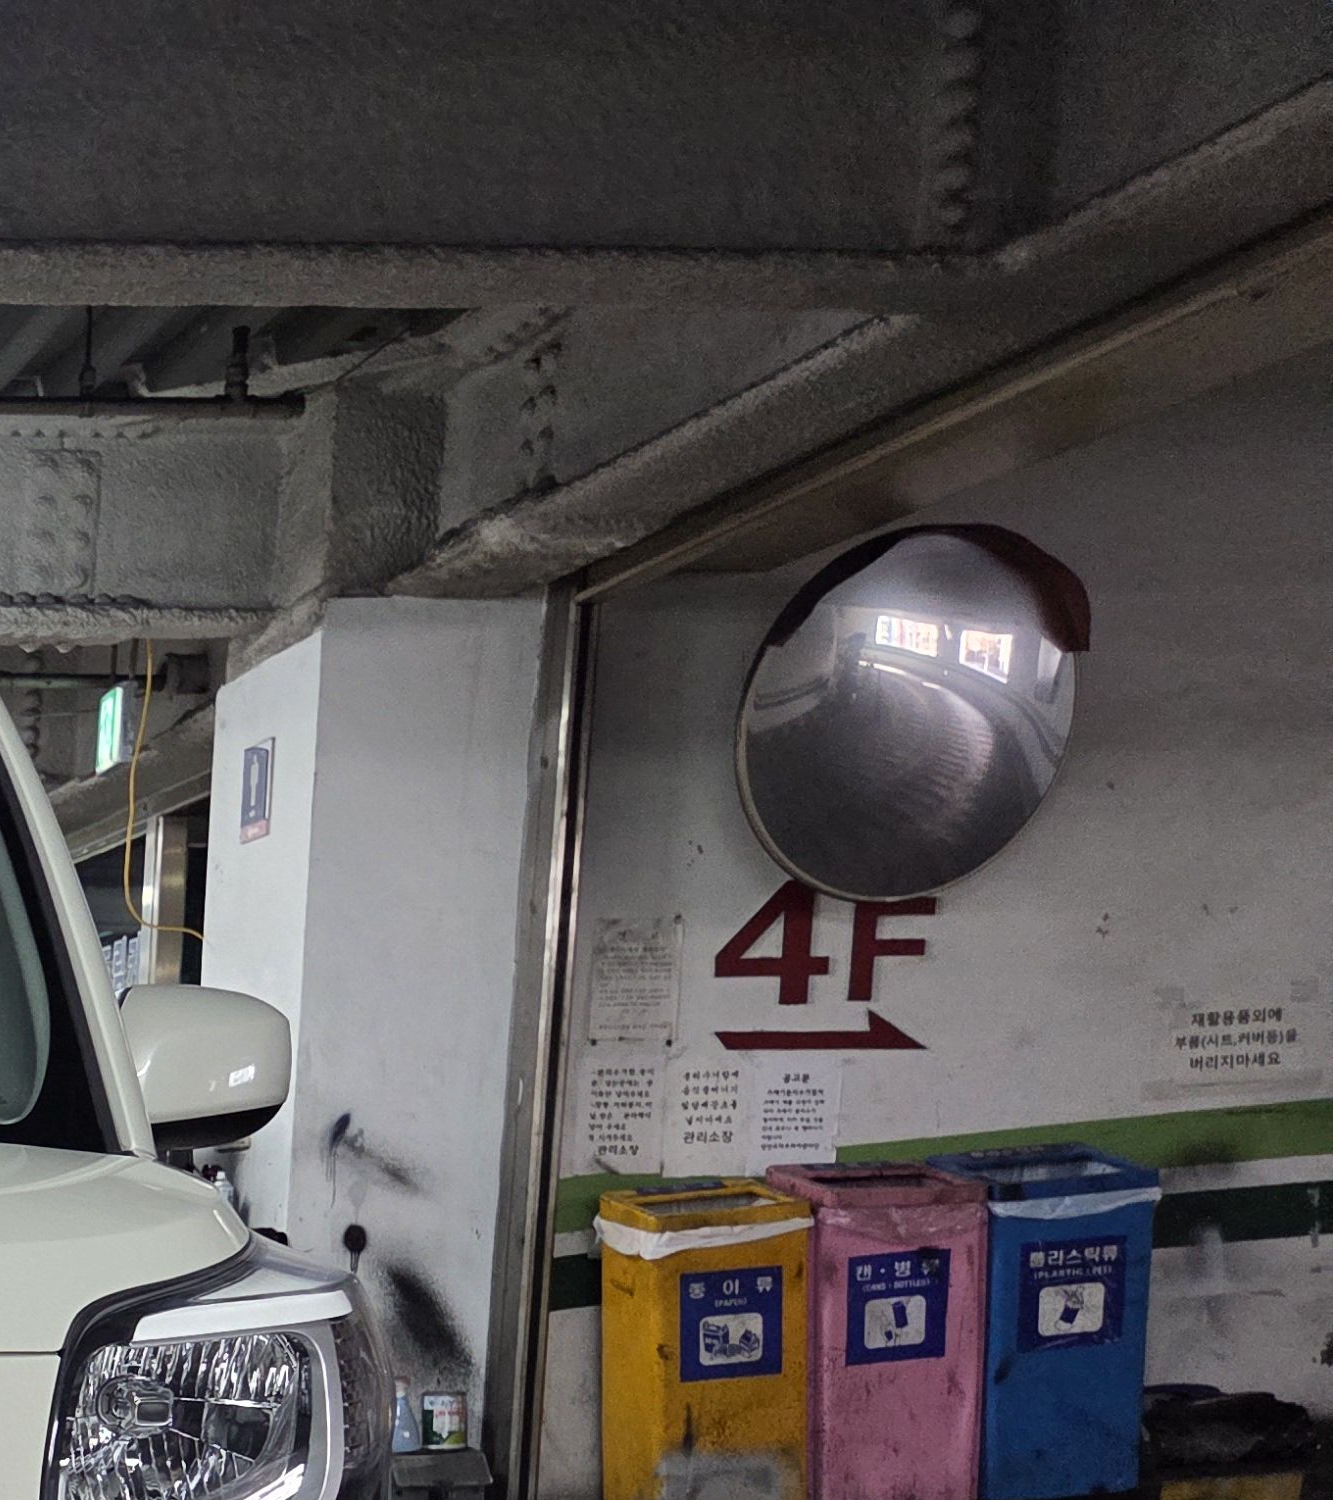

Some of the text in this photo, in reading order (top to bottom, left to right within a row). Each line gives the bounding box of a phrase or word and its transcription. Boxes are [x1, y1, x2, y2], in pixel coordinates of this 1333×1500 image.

[714, 879, 937, 1004] 4F
[1189, 1051, 1281, 1072] 버리지마세요
[683, 1130, 734, 1145] 관리소장
